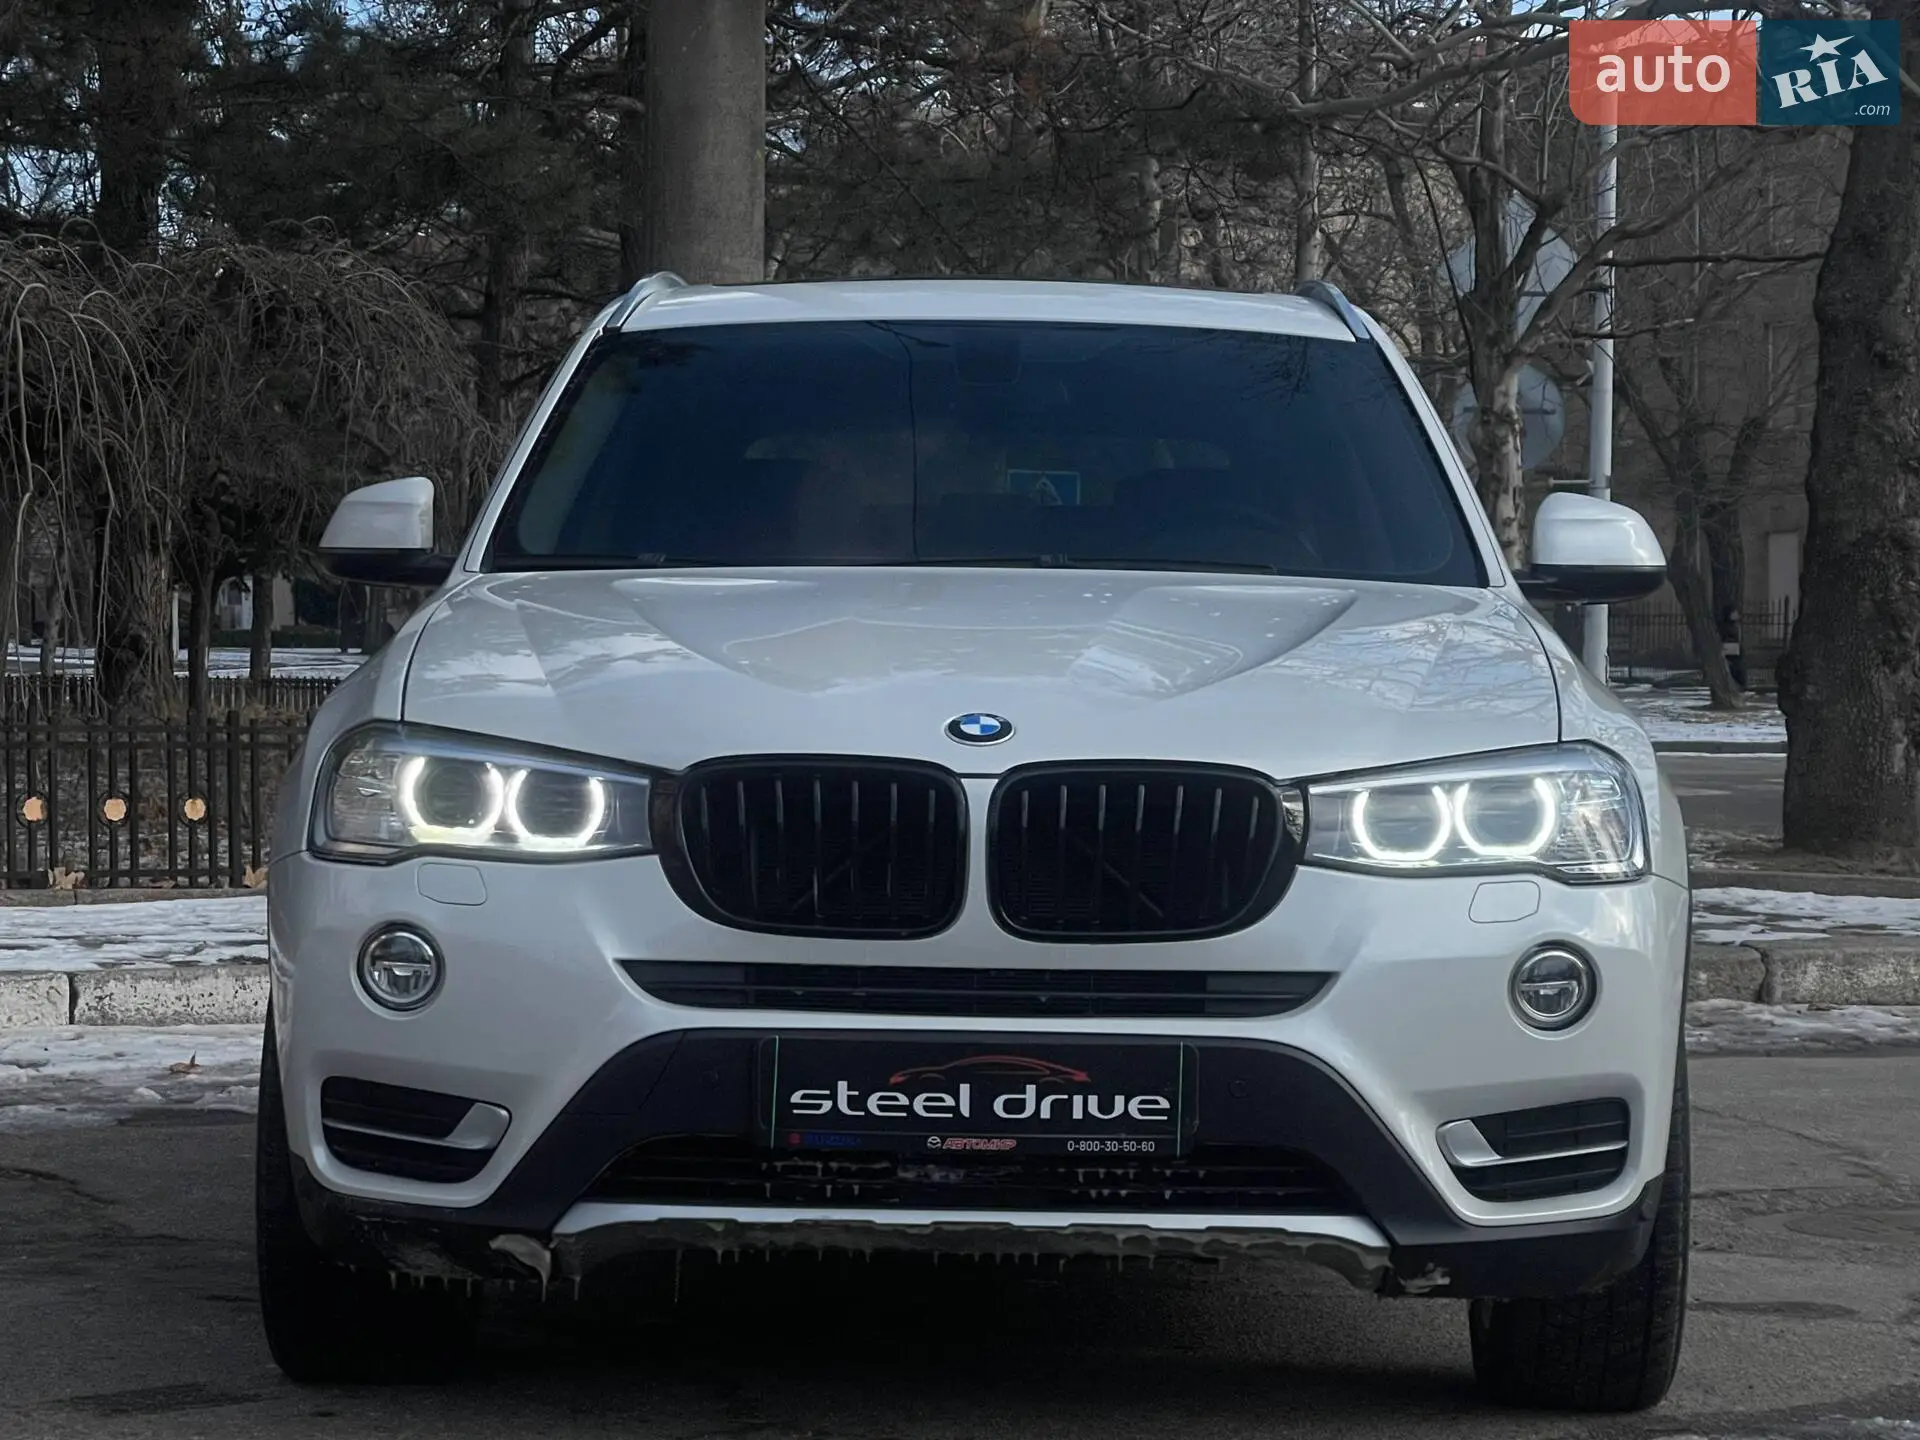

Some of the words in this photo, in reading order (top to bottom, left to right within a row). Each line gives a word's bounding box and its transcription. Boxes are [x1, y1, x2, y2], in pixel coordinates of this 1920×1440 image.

[790, 1080, 970, 1118] steel
[993, 1084, 1170, 1120] drive
[1067, 1140, 1155, 1152] 0-800-30-50-60
